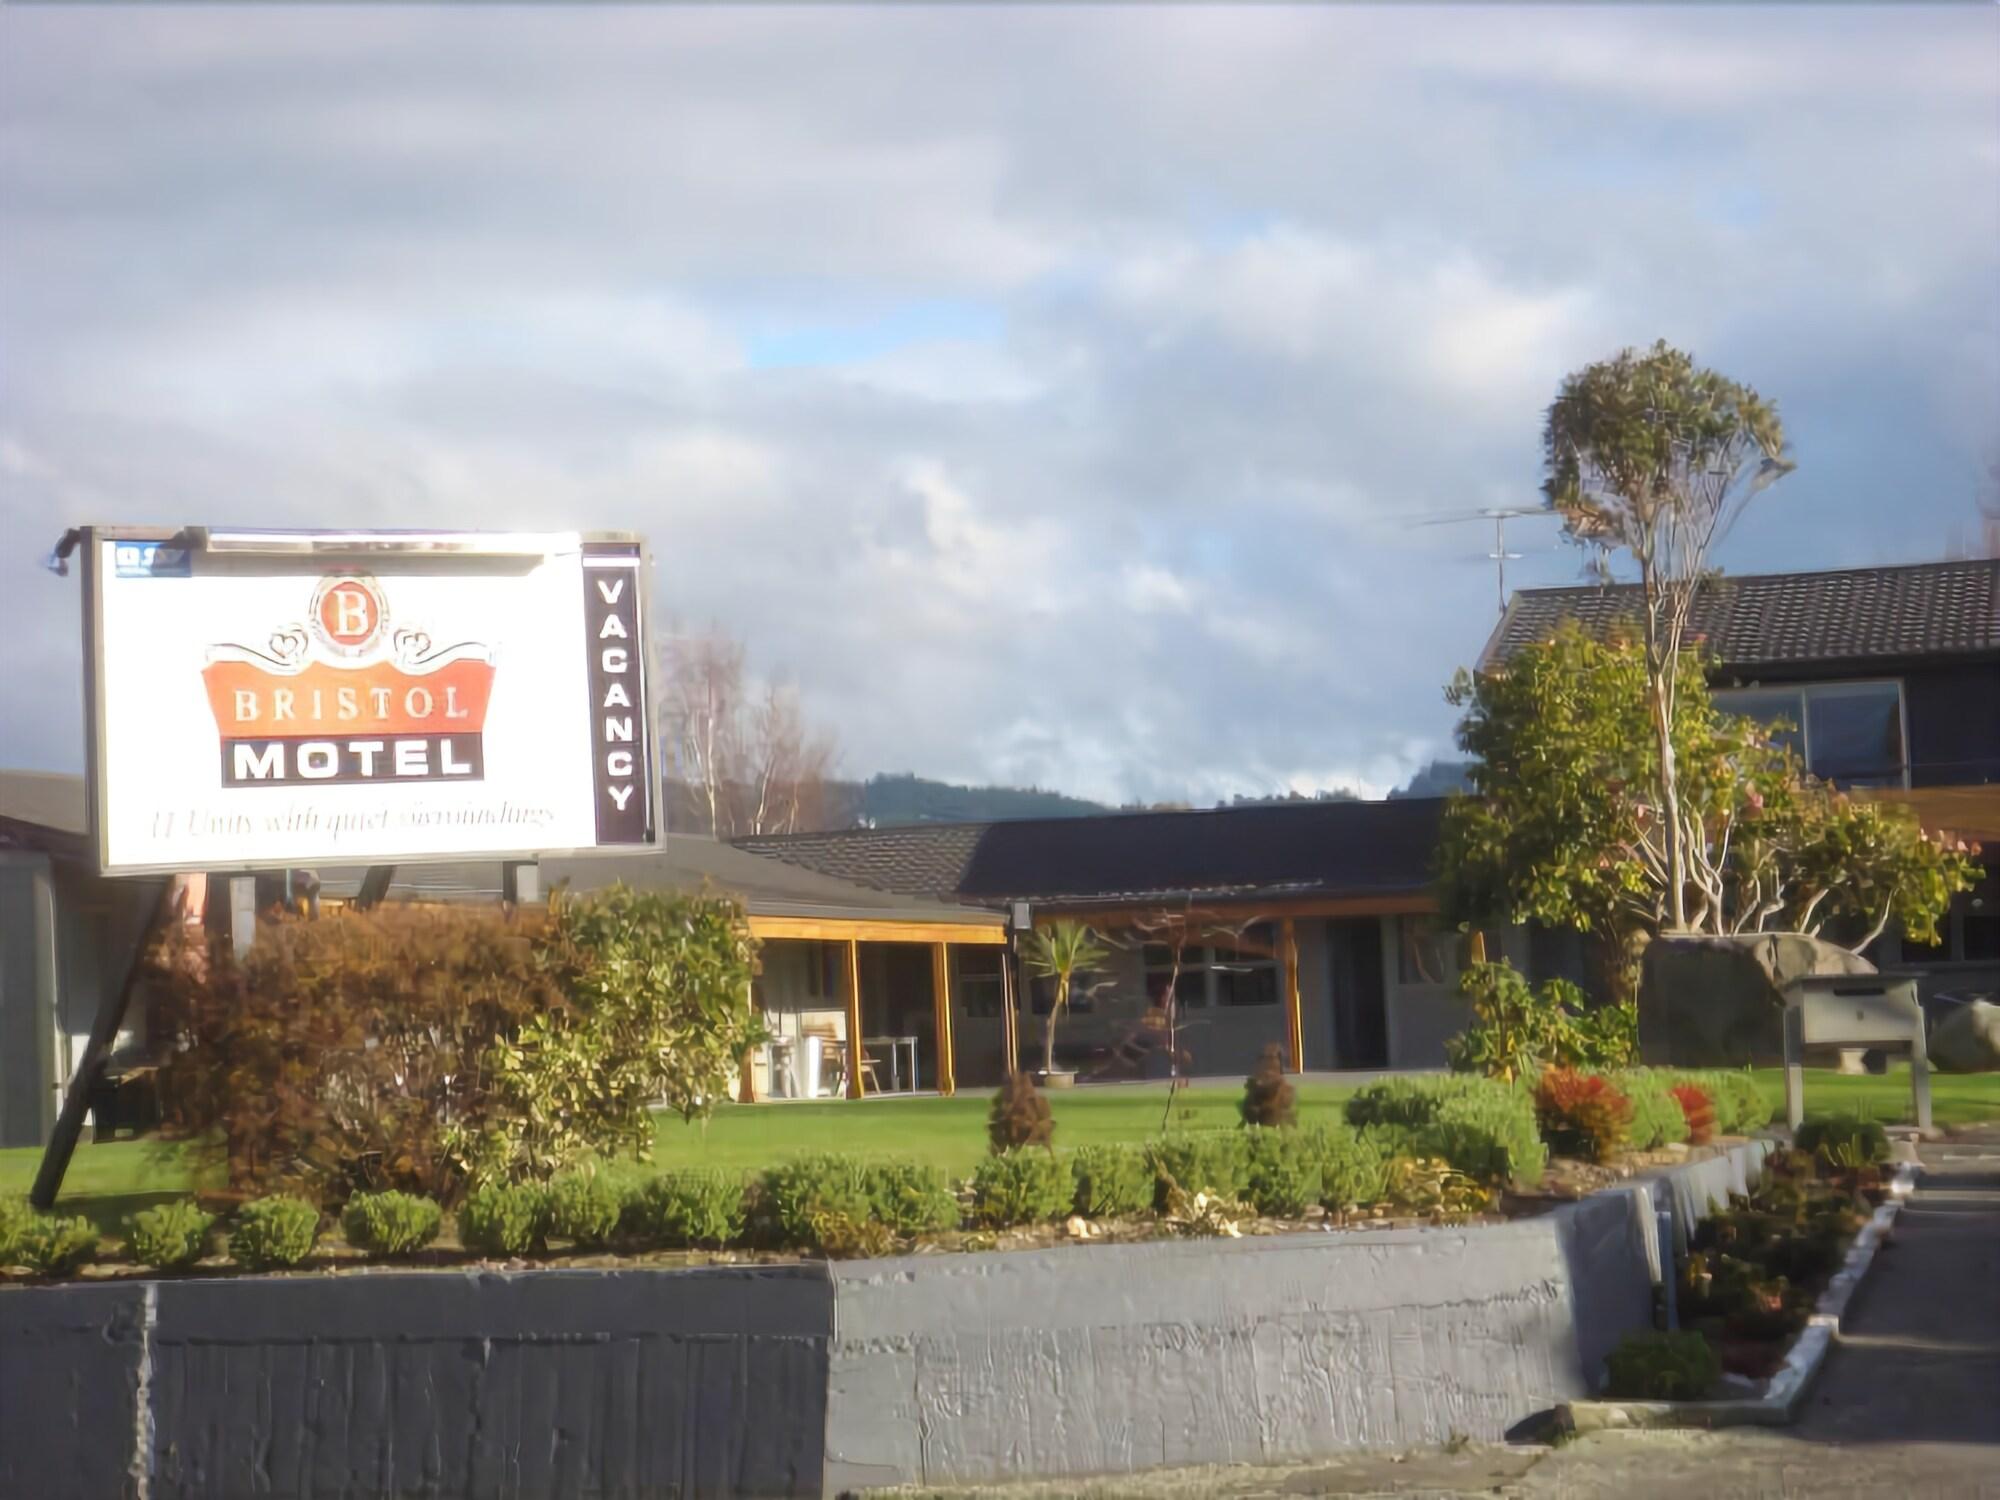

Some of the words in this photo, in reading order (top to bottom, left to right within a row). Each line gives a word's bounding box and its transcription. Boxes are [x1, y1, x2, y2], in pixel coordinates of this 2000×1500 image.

[337, 590, 369, 637] B
[234, 687, 469, 722] BRISTOL
[597, 579, 634, 811] VACANCY
[233, 740, 472, 780] MOTEL
